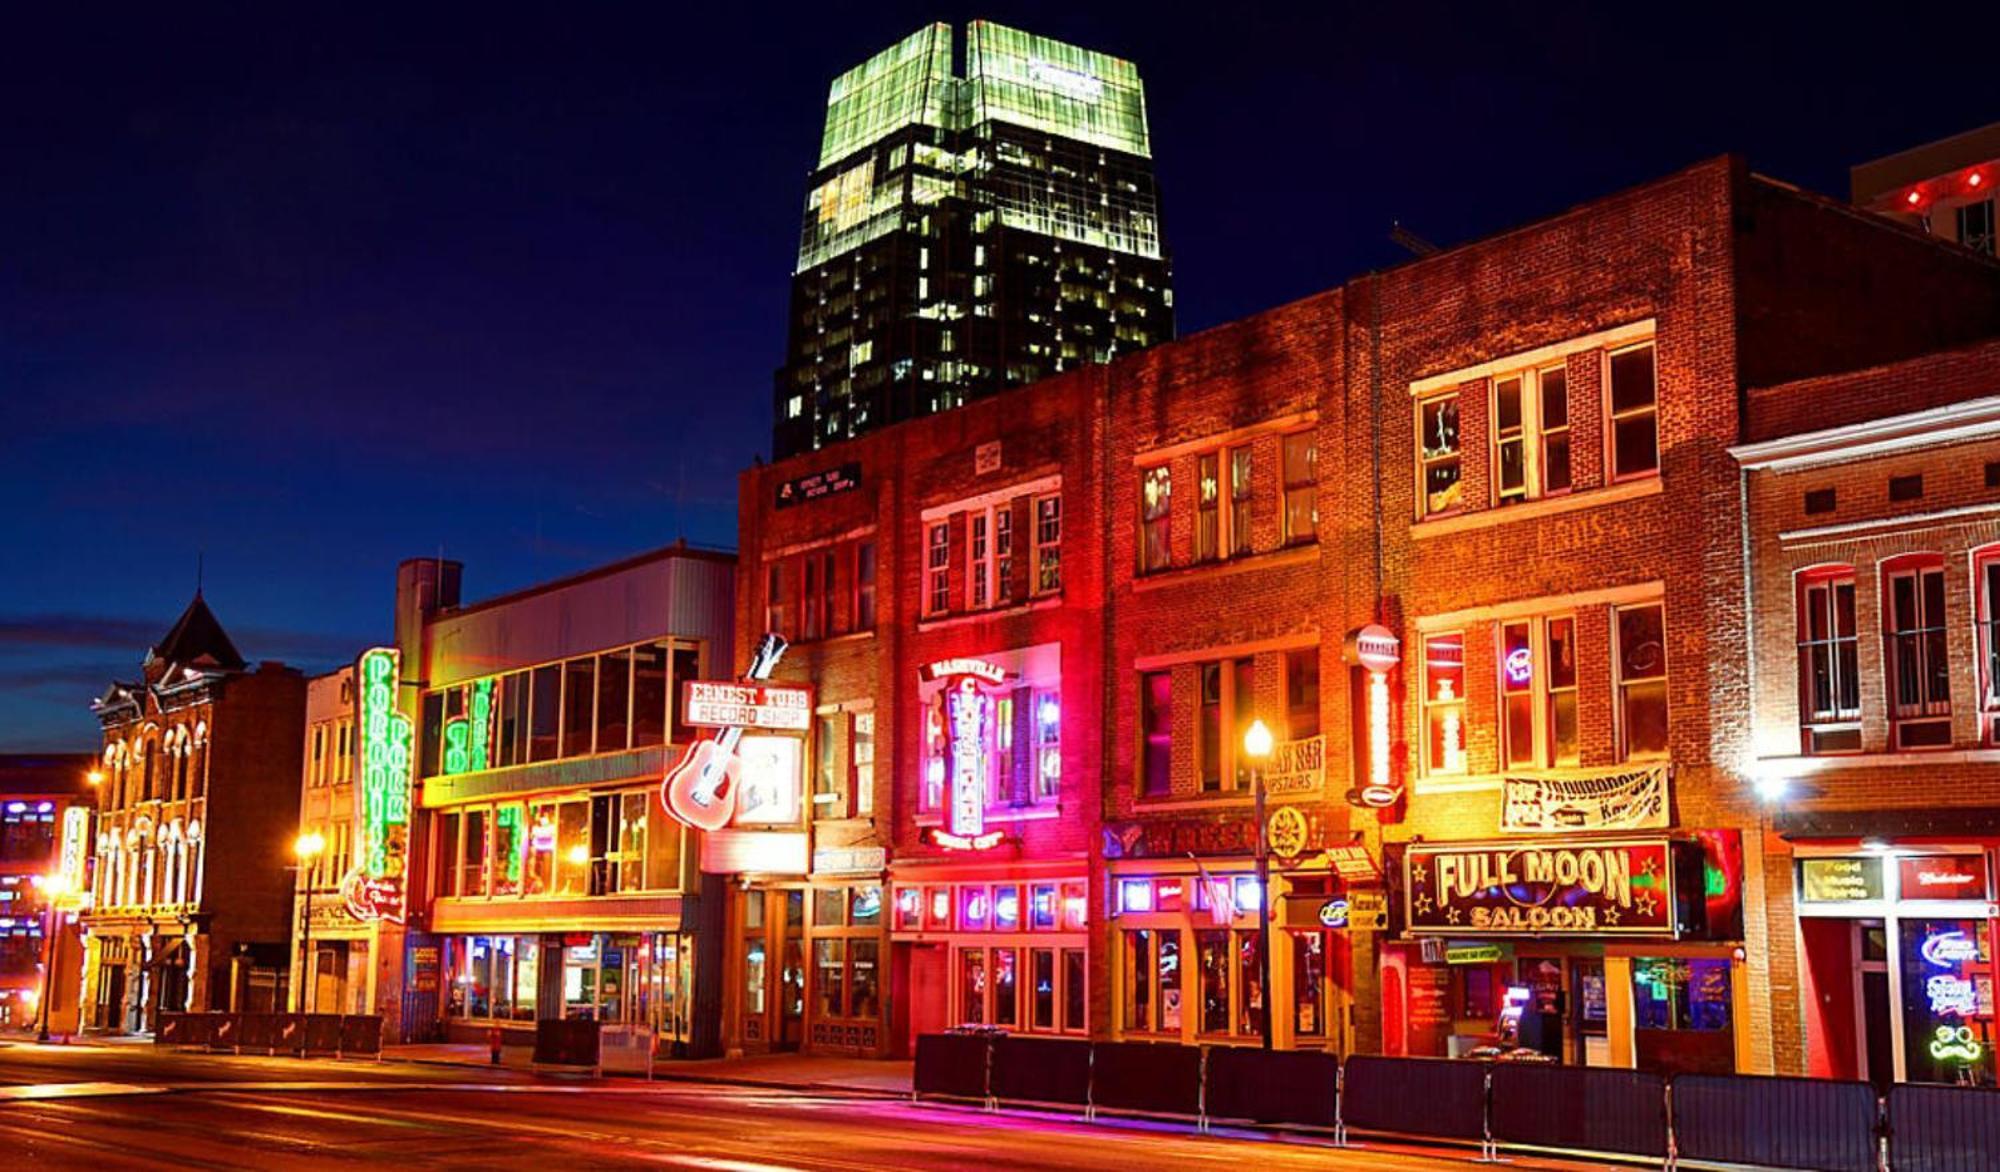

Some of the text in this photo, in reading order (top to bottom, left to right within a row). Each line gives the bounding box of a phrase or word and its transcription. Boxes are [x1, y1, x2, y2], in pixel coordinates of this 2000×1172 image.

[691, 683, 758, 705] ERNEST
[764, 688, 808, 709] TUBB
[699, 705, 758, 724] RECORD
[762, 709, 802, 726] SHOP
[388, 718, 408, 823] PARK
[1435, 851, 1518, 908] FULL
[1524, 849, 1632, 909] MOON
[1470, 906, 1596, 930] SALOON
